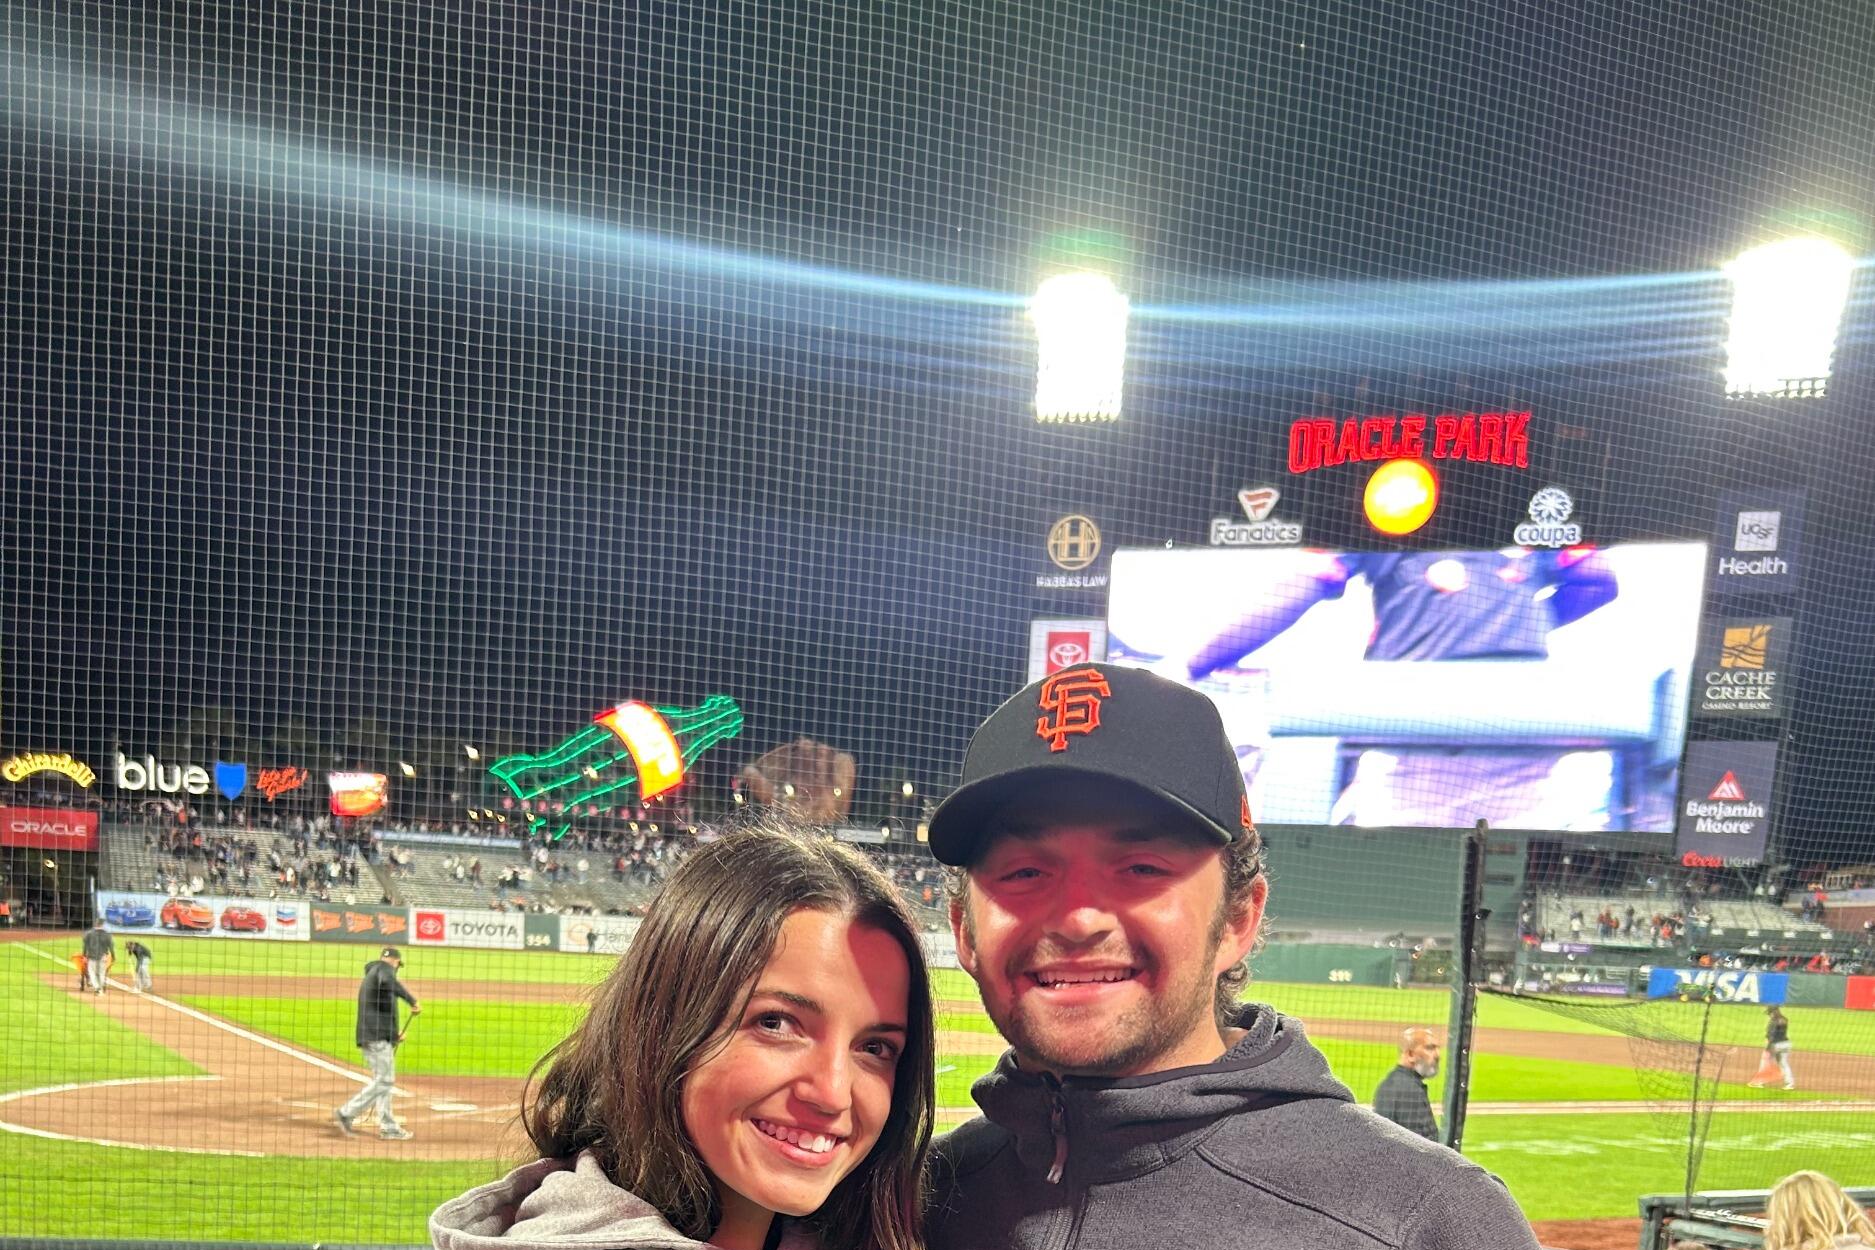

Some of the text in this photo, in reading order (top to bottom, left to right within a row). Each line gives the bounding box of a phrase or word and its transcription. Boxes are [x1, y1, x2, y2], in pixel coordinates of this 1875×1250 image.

[1288, 411, 1533, 474] ORACLE PARK
[1212, 520, 1301, 544] Fanatics
[1516, 523, 1580, 547] coupa
[1718, 556, 1788, 576] Health
[1705, 671, 1777, 686] CACHE
[1705, 686, 1773, 700] CREEK
[118, 751, 210, 795] blue
[1686, 800, 1765, 820] Benjamin
[10, 821, 87, 837] ORACLE
[450, 921, 519, 938] TOYOTA
